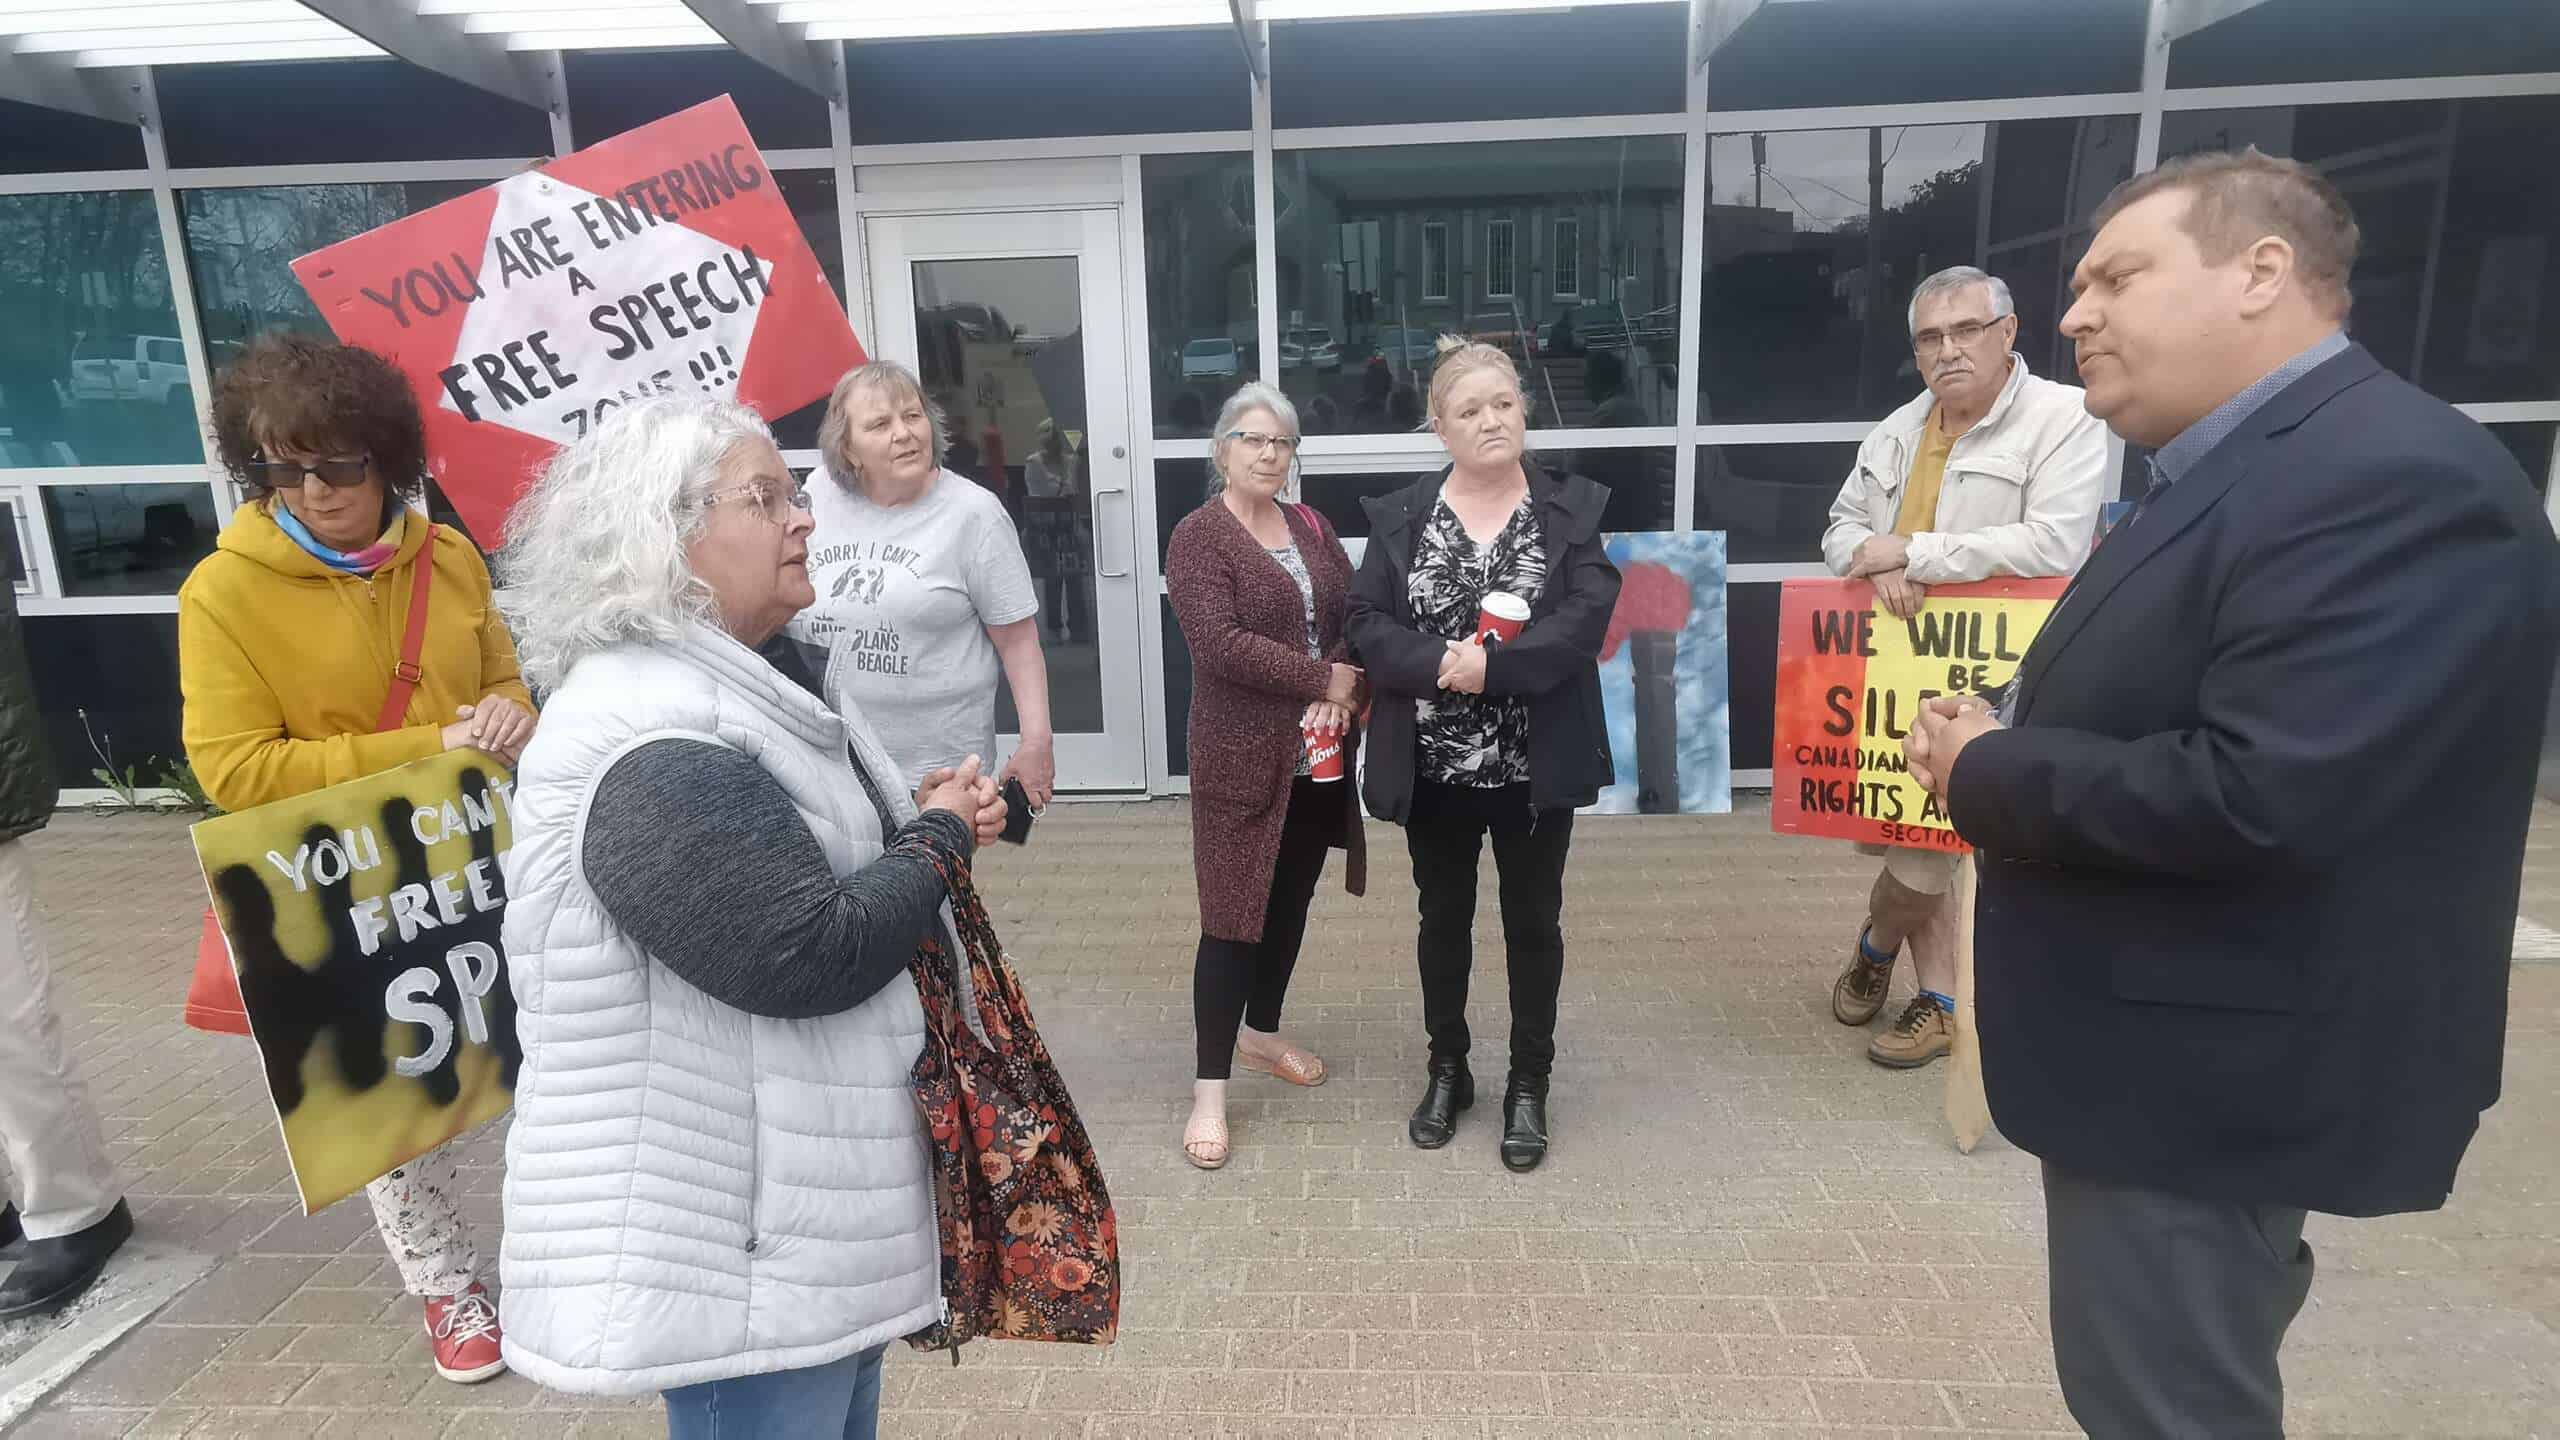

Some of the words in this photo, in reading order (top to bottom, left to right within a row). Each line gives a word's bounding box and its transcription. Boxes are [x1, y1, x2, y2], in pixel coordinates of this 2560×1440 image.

[361, 253, 484, 328] YOU
[494, 217, 574, 287] ARE
[573, 143, 762, 249] ENTERING
[568, 266, 596, 296] A
[437, 330, 578, 423] FREE
[590, 245, 774, 360] SPEECH
[815, 542, 861, 567] SORRY,
[869, 540, 876, 560] I
[1812, 610, 1878, 657] WE
[1906, 611, 2020, 661] WILL
[857, 651, 909, 674] BEAGLE
[1947, 664, 1990, 691] BE
[1795, 745, 1909, 773] CANADIAN
[1800, 777, 1904, 822] RIGHTS
[267, 826, 382, 892] YOU
[410, 777, 513, 845] CAN'T
[1880, 823, 1966, 848] SECTIO
[349, 857, 506, 957] FREE
